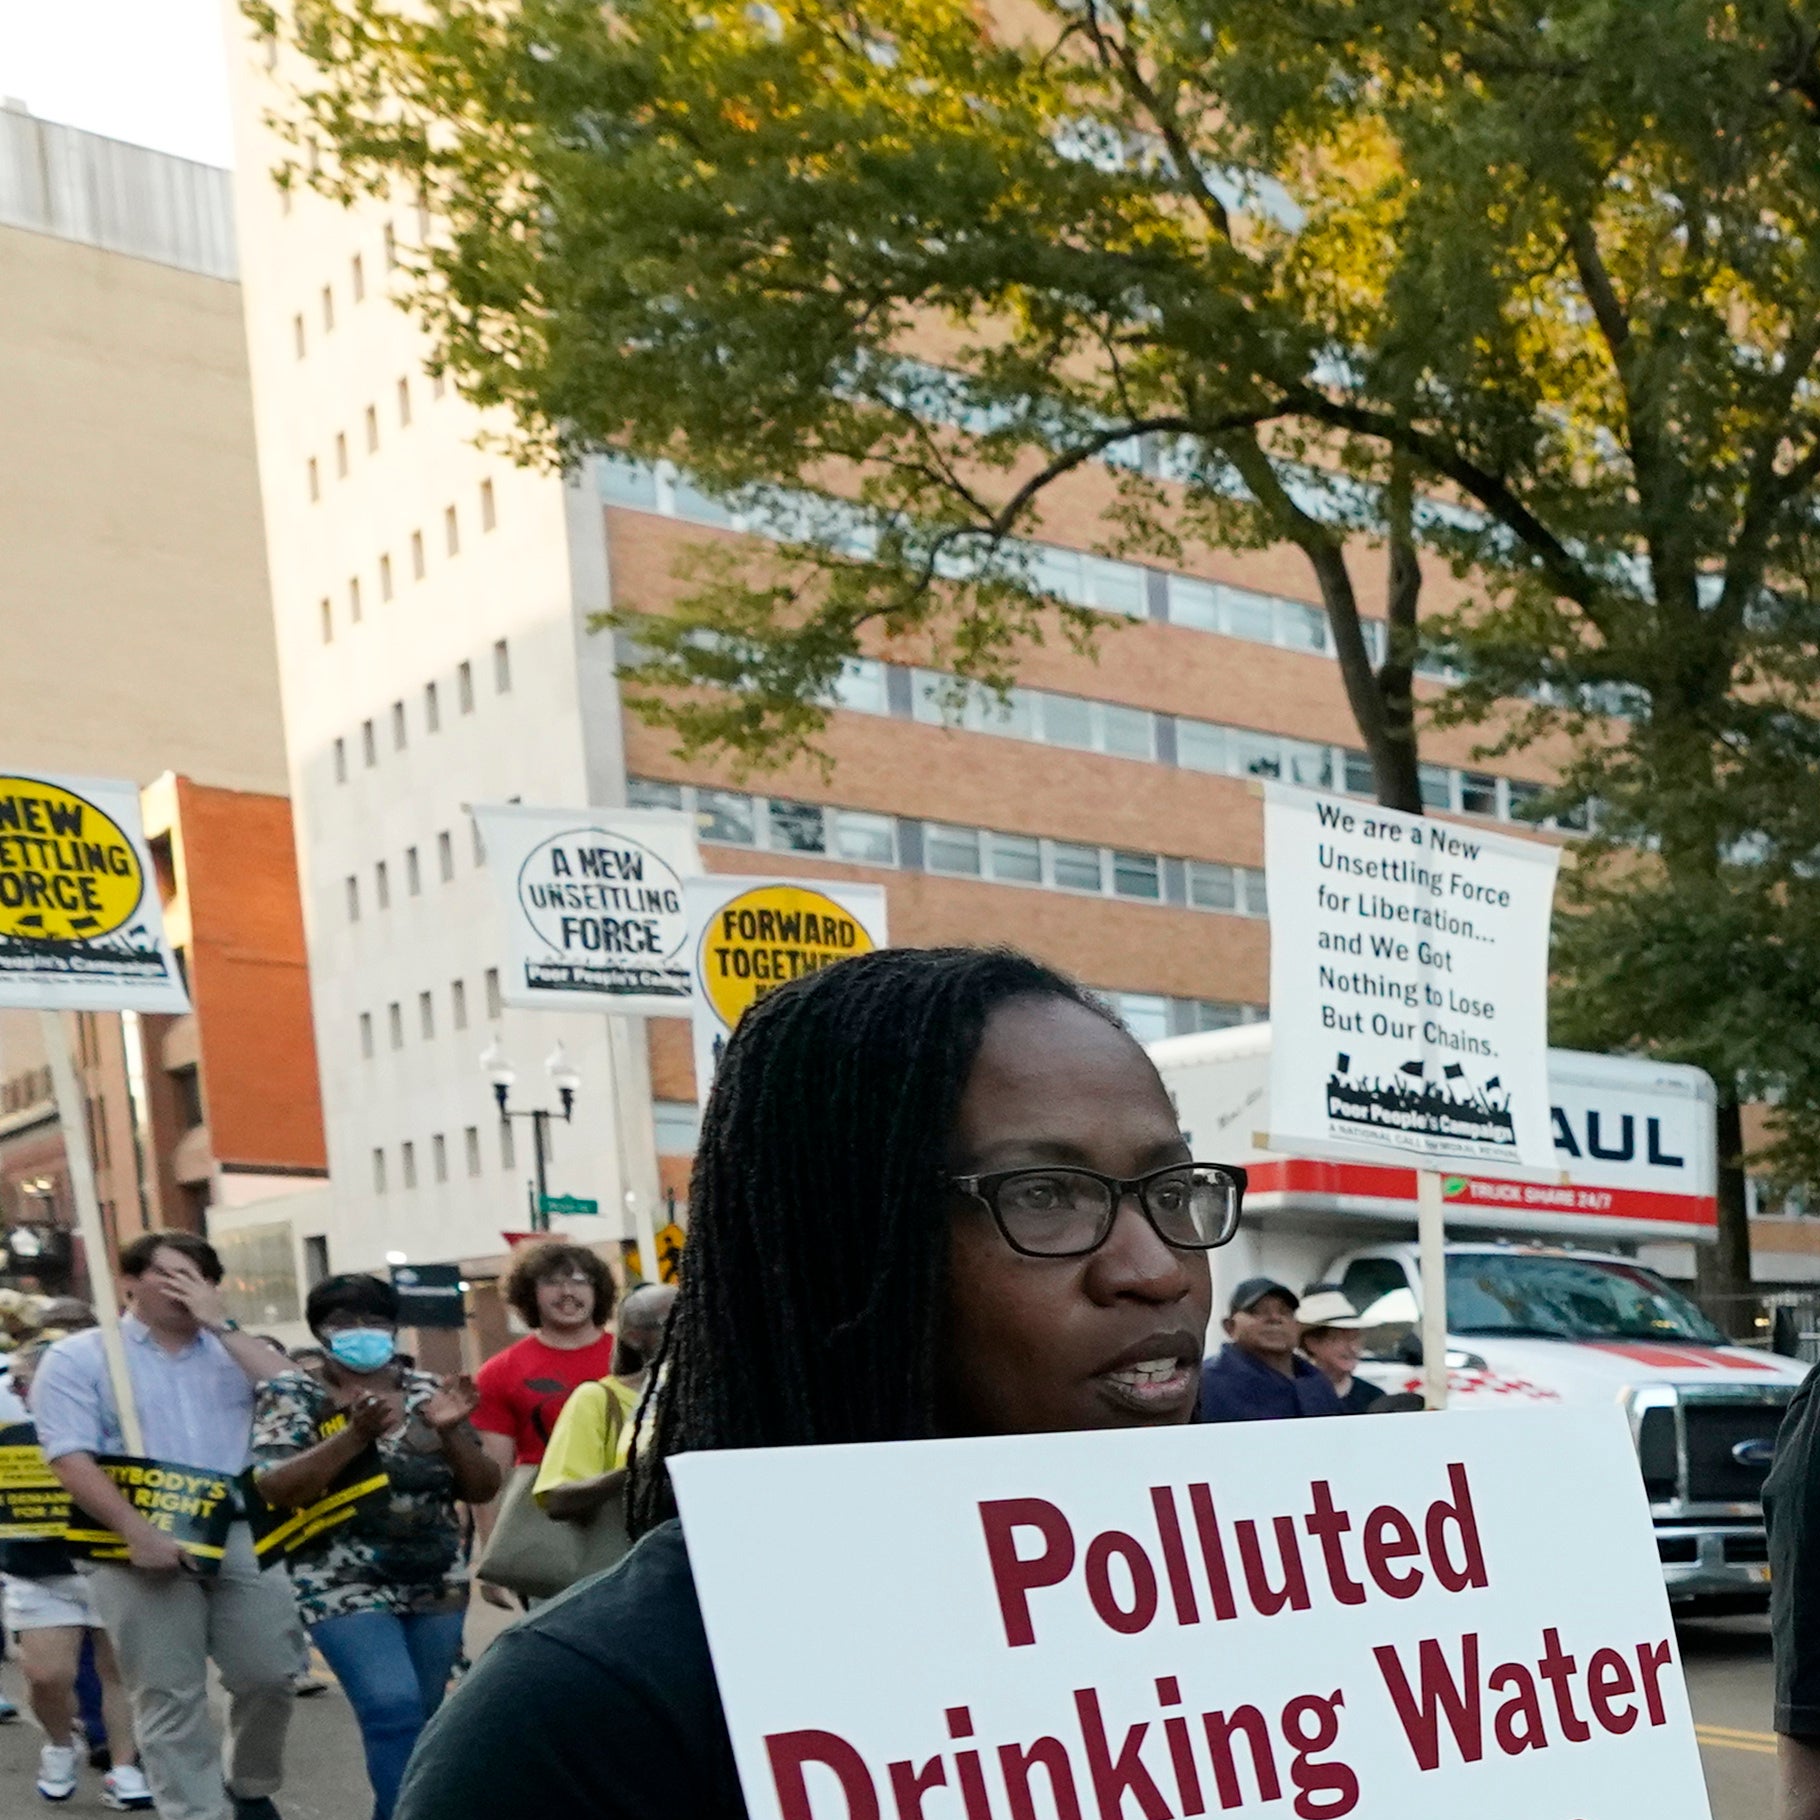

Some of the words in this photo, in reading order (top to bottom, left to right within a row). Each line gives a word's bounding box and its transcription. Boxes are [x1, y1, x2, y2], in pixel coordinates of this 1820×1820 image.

[1317, 802, 1354, 833] We
[1363, 817, 1402, 843] are
[1411, 825, 1423, 845] a
[1430, 828, 1482, 862] New
[552, 848, 573, 877] A
[577, 847, 643, 881] NEW
[1318, 844, 1443, 896] Unsettling
[1450, 872, 1511, 908] Force
[529, 883, 680, 915] UNSETTLING
[1317, 884, 1351, 913] for
[1358, 893, 1496, 945] Liberation...
[561, 916, 663, 954] FORCE
[721, 908, 856, 949] FORWARD
[714, 947, 850, 982] TOGETH
[1317, 930, 1362, 956] and
[1369, 934, 1409, 962] We
[1418, 941, 1453, 973] Got
[1319, 965, 1417, 1006] Nothing
[1425, 981, 1443, 1007] to
[1449, 988, 1496, 1020] Lose
[1321, 1005, 1364, 1034] But
[1371, 1013, 1416, 1041] Our
[1422, 1020, 1499, 1059] Chains.
[1329, 1096, 1369, 1121] Poor
[1370, 1103, 1440, 1133] People's
[1439, 1114, 1514, 1144] Campaign
[1470, 1180, 1521, 1202] TRUCK
[1524, 1185, 1575, 1207] SHARE
[135, 1487, 218, 1519] RIGHT
[979, 1463, 1488, 1647] Polluted
[1373, 1627, 1674, 1770] Water
